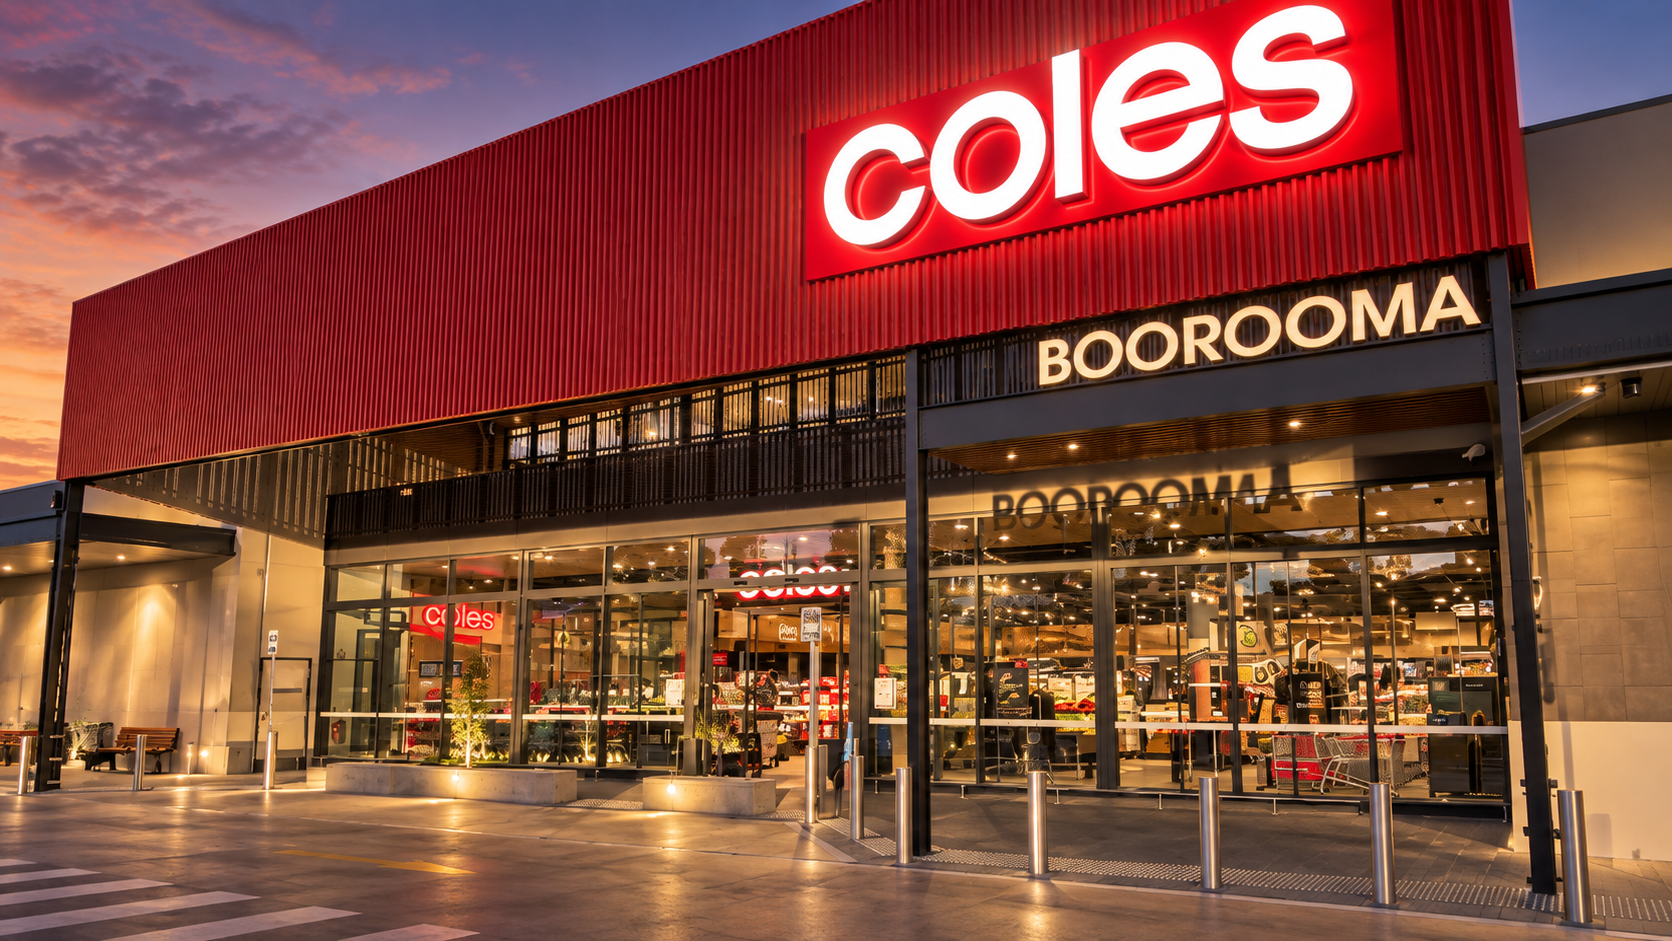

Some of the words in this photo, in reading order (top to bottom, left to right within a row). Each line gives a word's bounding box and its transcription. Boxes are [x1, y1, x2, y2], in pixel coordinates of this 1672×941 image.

[824, 5, 1354, 247] coles
[1038, 275, 1481, 386] BOOROOMA
[426, 605, 494, 629] coles
